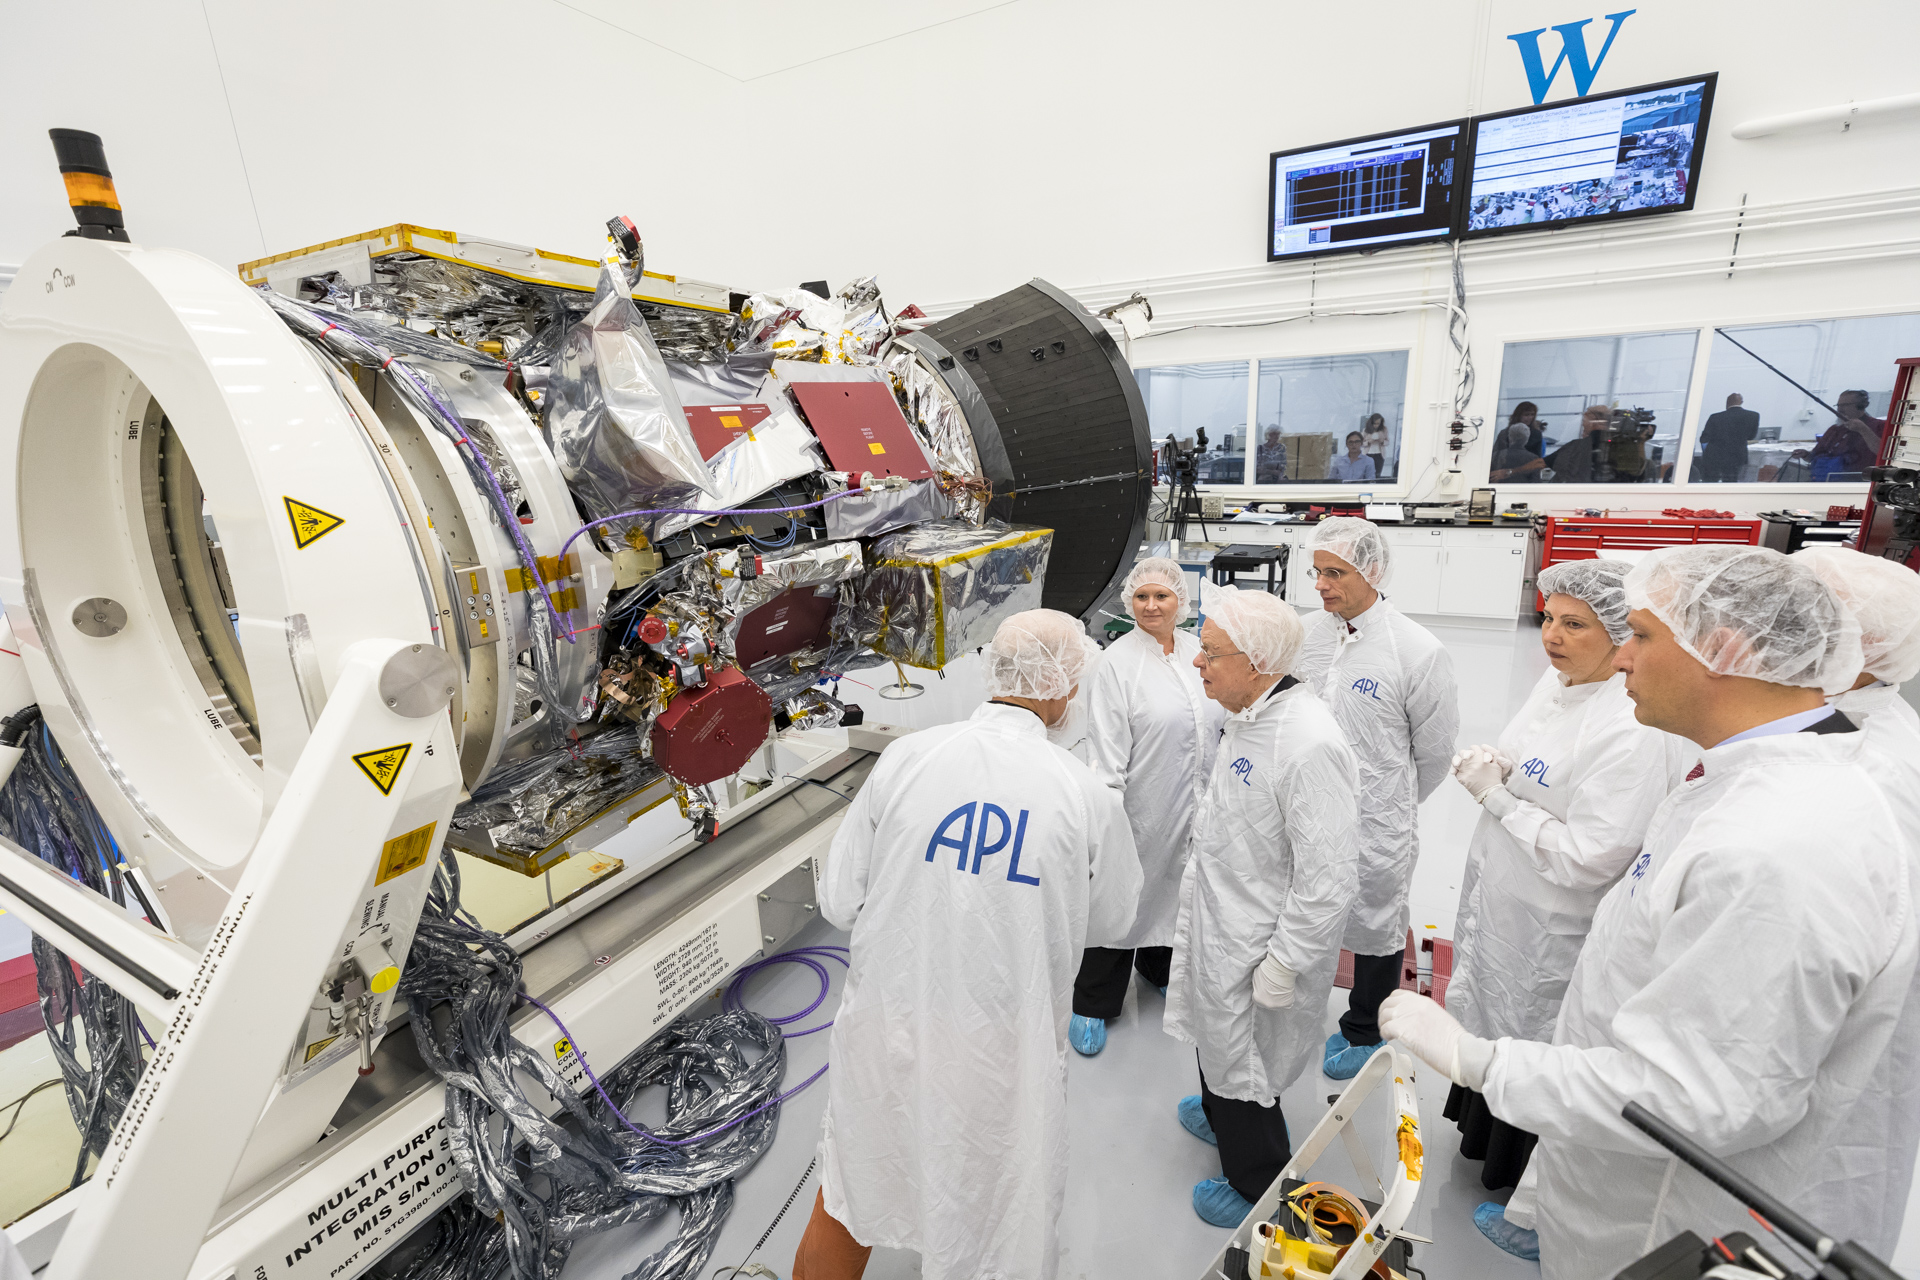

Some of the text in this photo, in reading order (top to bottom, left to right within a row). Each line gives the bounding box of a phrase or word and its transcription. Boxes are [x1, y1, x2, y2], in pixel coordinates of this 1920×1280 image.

[1531, 113, 1544, 121] Daily
[1545, 108, 1570, 118] Schedule
[128, 420, 140, 440] LUBE
[1352, 678, 1381, 700] APL
[204, 708, 223, 730] LUBE
[1230, 757, 1254, 787] APL
[1520, 757, 1550, 788] APL
[925, 801, 1040, 886] APL
[360, 898, 375, 929] SLEWING
[376, 892, 390, 921] MANUAL
[653, 951, 678, 971] LENGTH:
[712, 922, 718, 930] in
[655, 961, 677, 979] WIDTH:
[677, 949, 691, 964] 2728
[658, 966, 682, 986] HEIGHT:
[712, 940, 718, 948] in
[659, 979, 679, 996] MASS:
[688, 975, 699, 987] 800
[106, 891, 254, 1190] ACCORDING TO THE USER MANUAL
[114, 915, 231, 1146] OPERATING AND HANDLING
[557, 1051, 575, 1066] COG
[557, 1050, 588, 1076] LOADD
[306, 1115, 449, 1226] MULTI PURPO
[285, 1149, 435, 1267] INTEGRATION
[352, 1204, 393, 1241] MIS
[398, 1174, 430, 1206] S/N
[329, 1251, 360, 1278] PART
[362, 1237, 382, 1252] NO.
